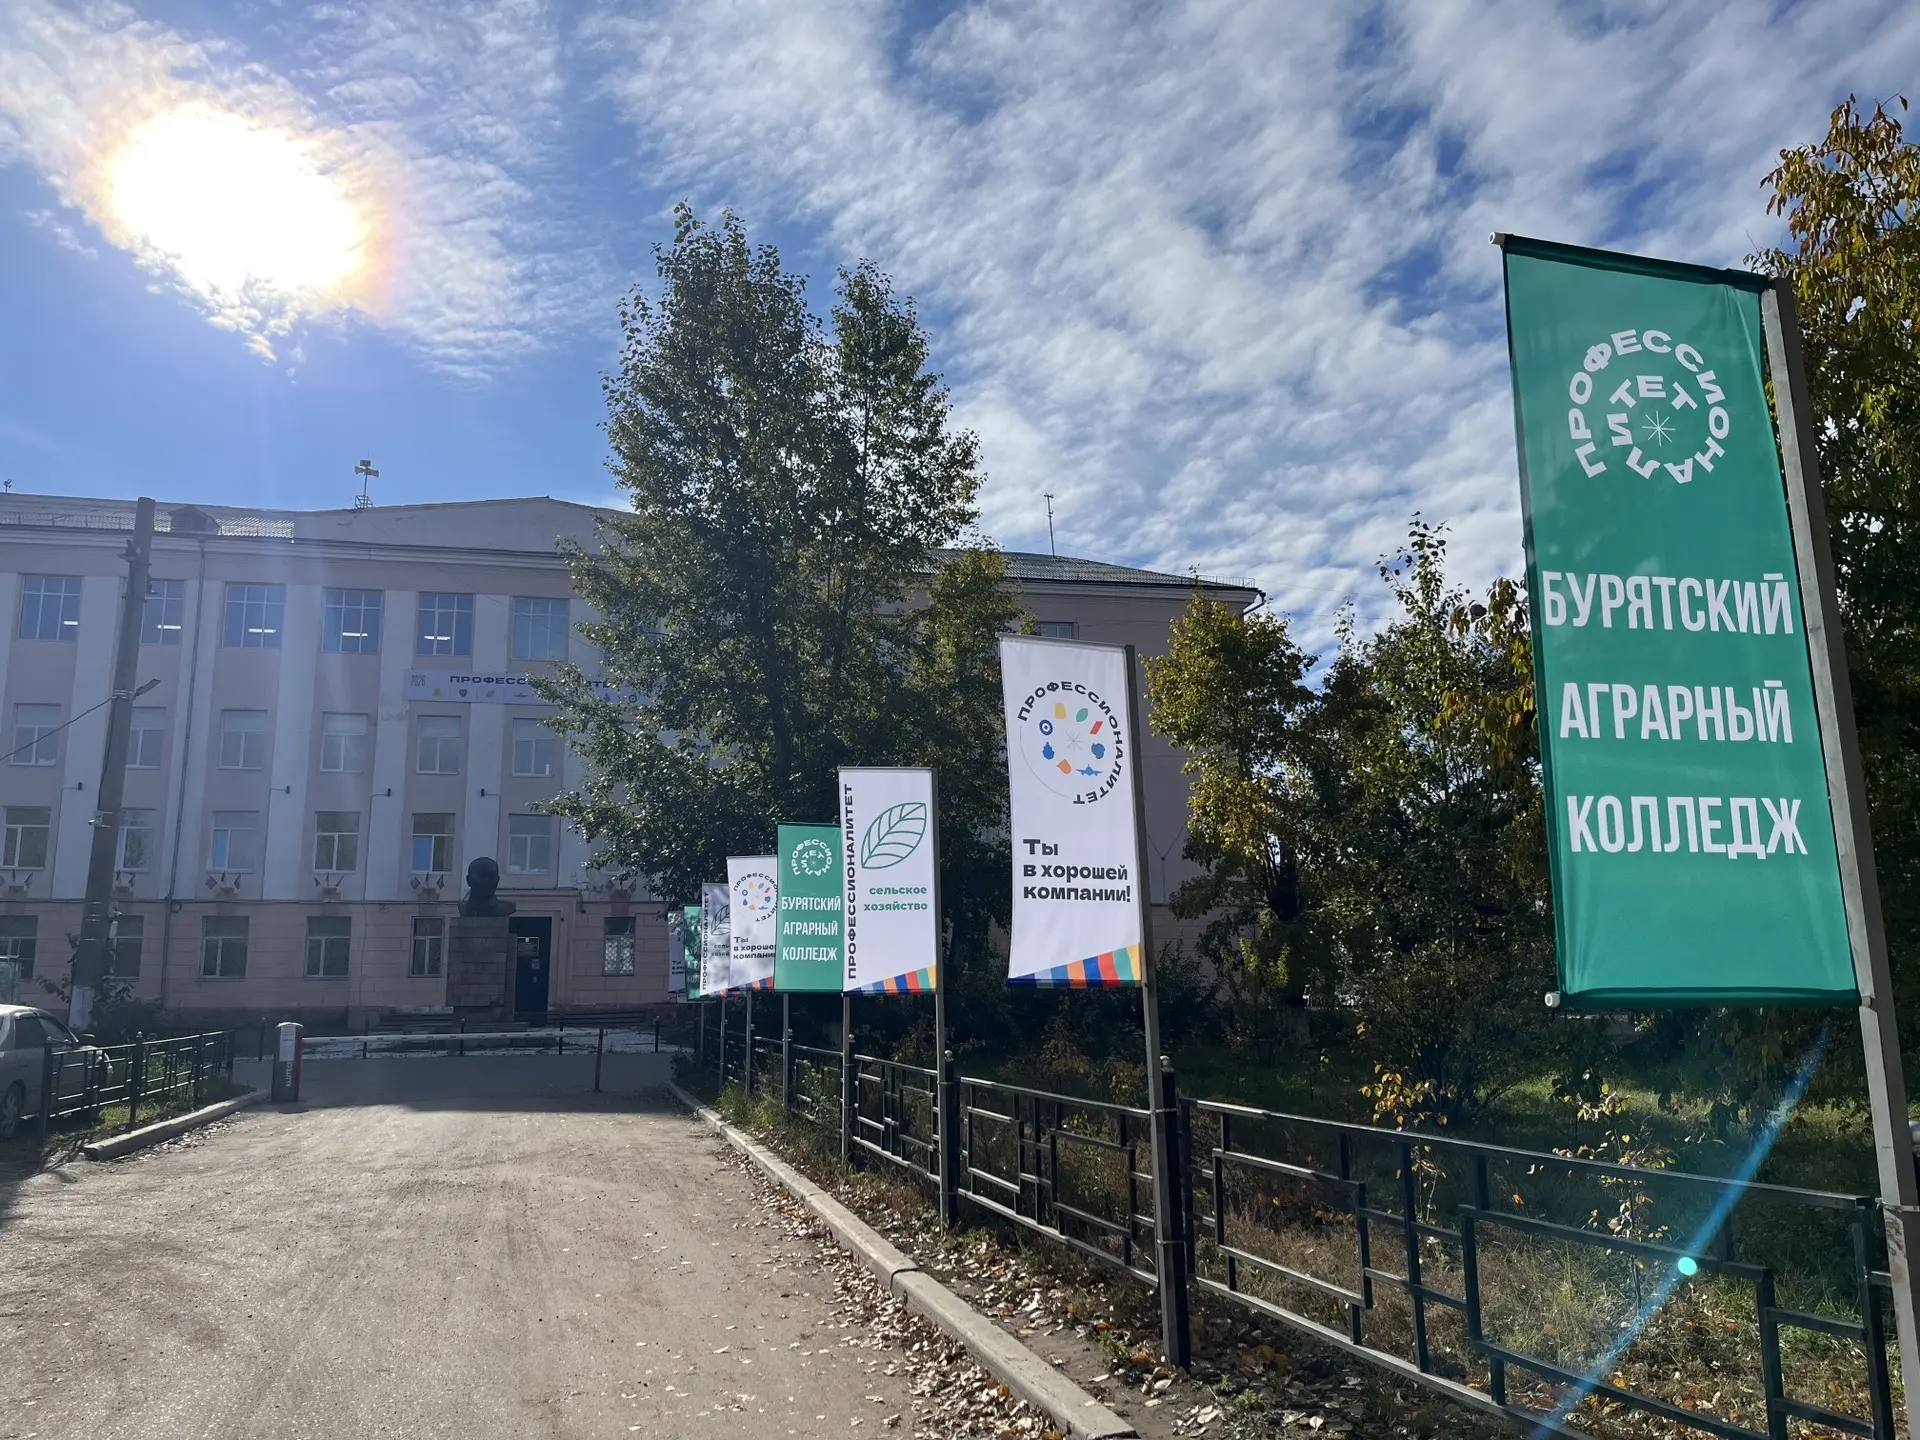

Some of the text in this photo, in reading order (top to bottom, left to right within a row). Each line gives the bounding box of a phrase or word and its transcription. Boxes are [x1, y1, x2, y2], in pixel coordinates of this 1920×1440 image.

[1568, 329, 1730, 484] ПРОФЕССИОНАЛИТЕТ
[1543, 571, 1794, 635] БУРЯТСКИЙ
[1560, 680, 1793, 744] АГРАРНЫЙ
[1017, 681, 1123, 805] ПРОФЕССИОНАЛИТЕТ
[1567, 795, 1808, 860] КОЛЛЕДЖ
[1022, 838, 1058, 856] Ты
[844, 783, 857, 979] ПРОФЕССИОНАЛИТЕТ
[1023, 864, 1128, 883] в хорошей
[869, 886, 927, 895] сельское
[1023, 885, 1131, 902] компании!
[781, 896, 841, 911] БУРЯТСКИЙ
[863, 900, 927, 911] хозяйство
[783, 920, 838, 936] АГРАРНЫЙ
[733, 952, 776, 960] компани
[740, 944, 776, 952] хороше
[782, 946, 838, 962] КОЛЛЕДЖ
